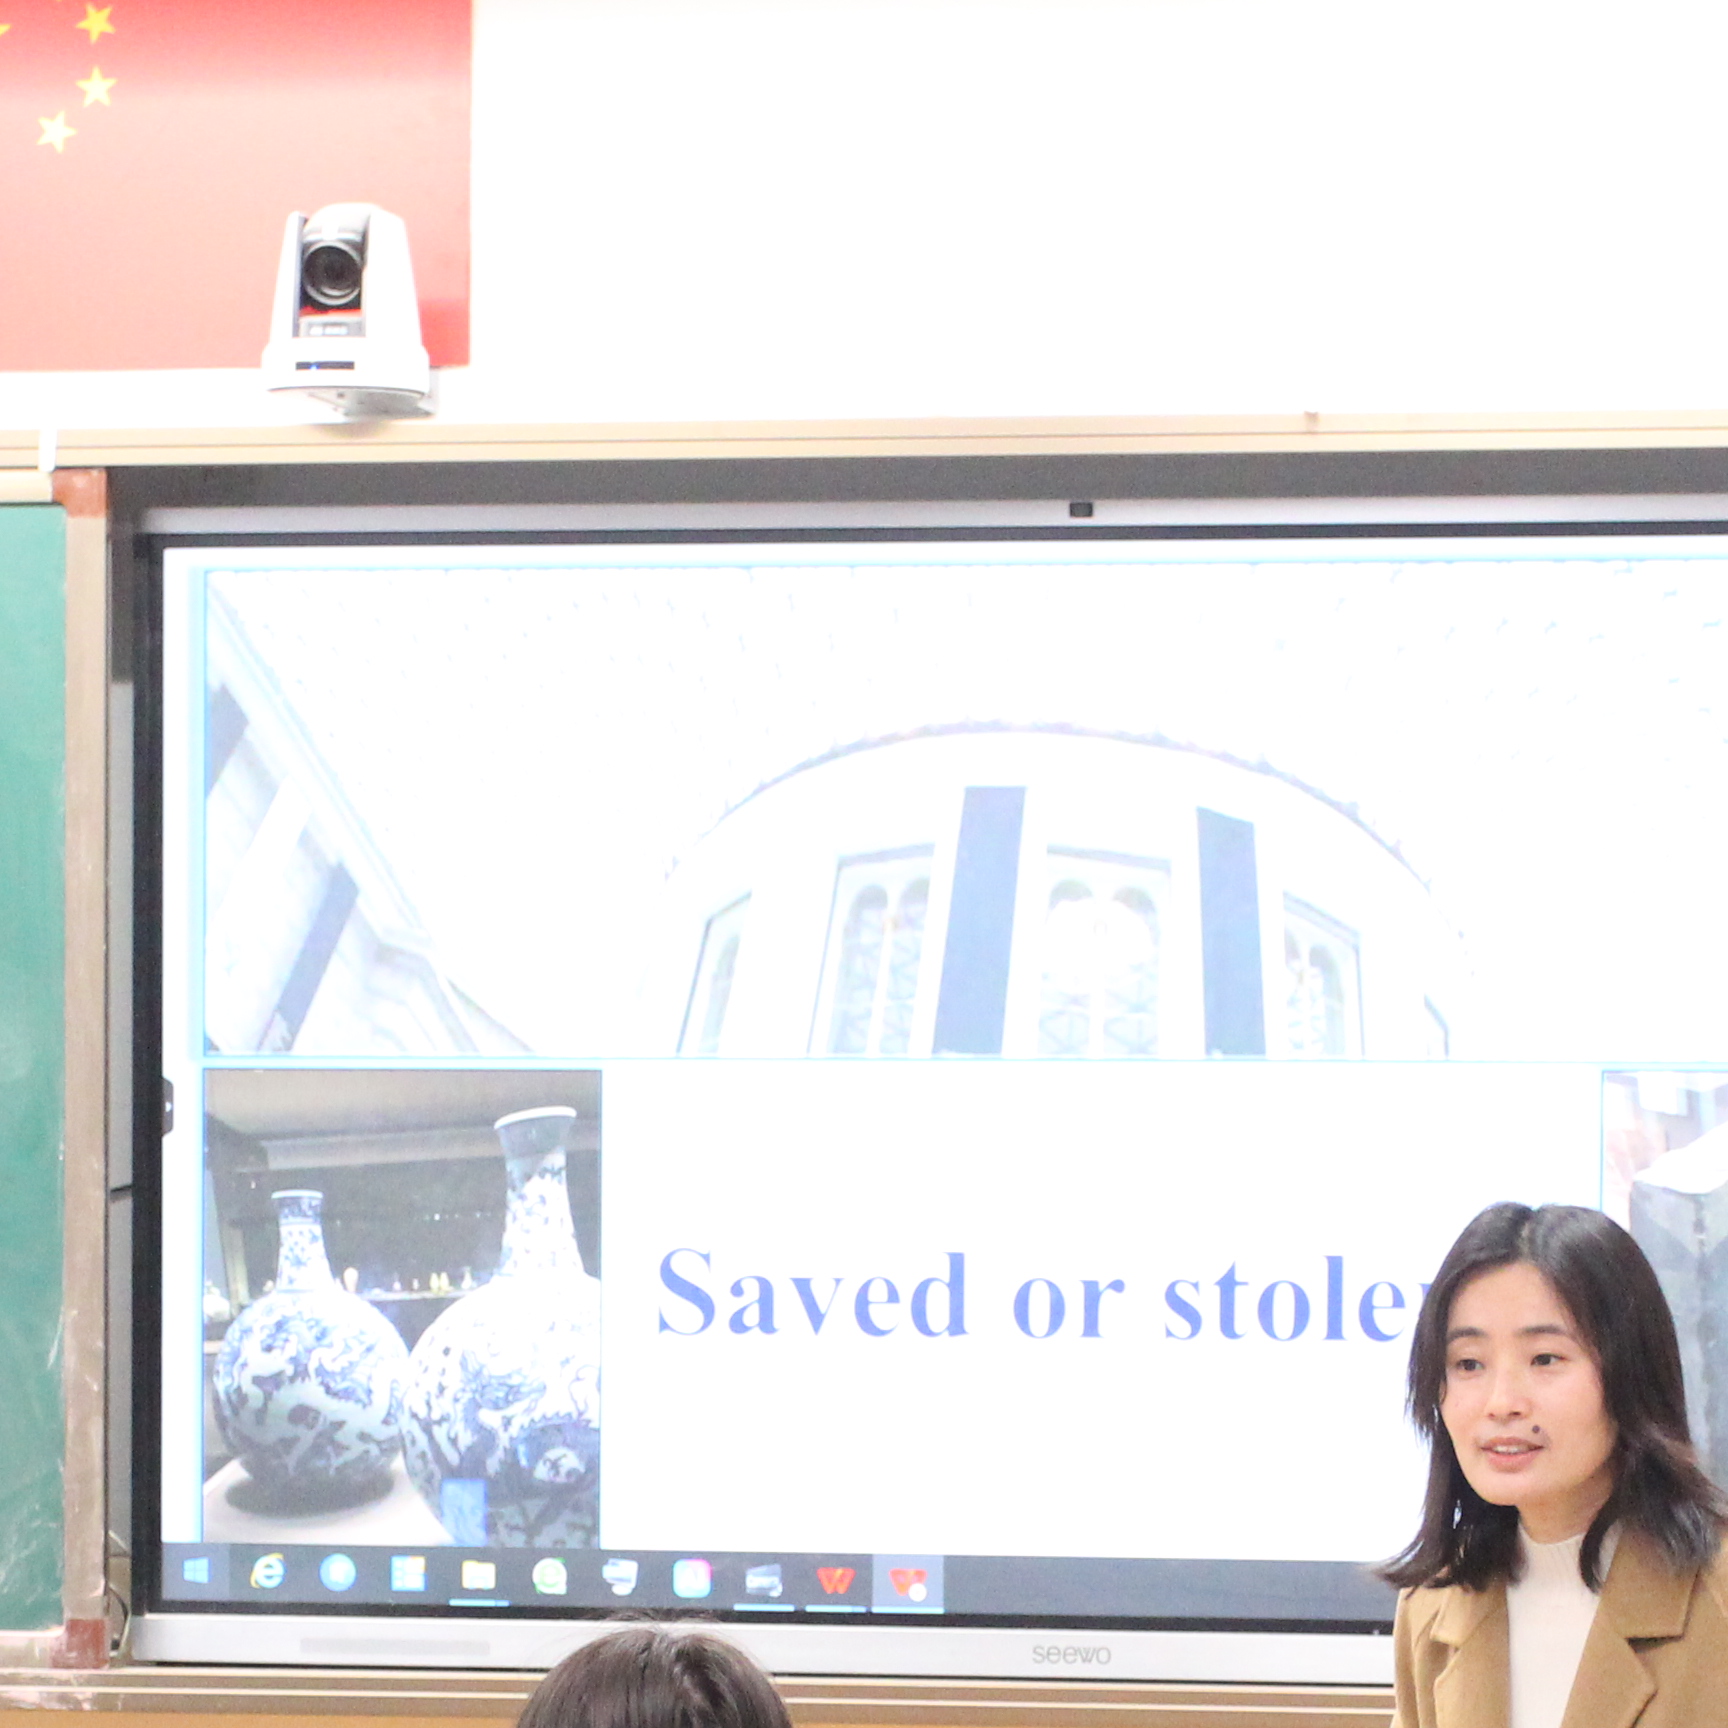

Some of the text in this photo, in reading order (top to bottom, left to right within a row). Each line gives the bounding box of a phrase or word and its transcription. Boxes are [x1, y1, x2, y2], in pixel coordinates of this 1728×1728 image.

[658, 1247, 1433, 1343] Saved or stole
[1031, 1644, 1112, 1665] seewo
